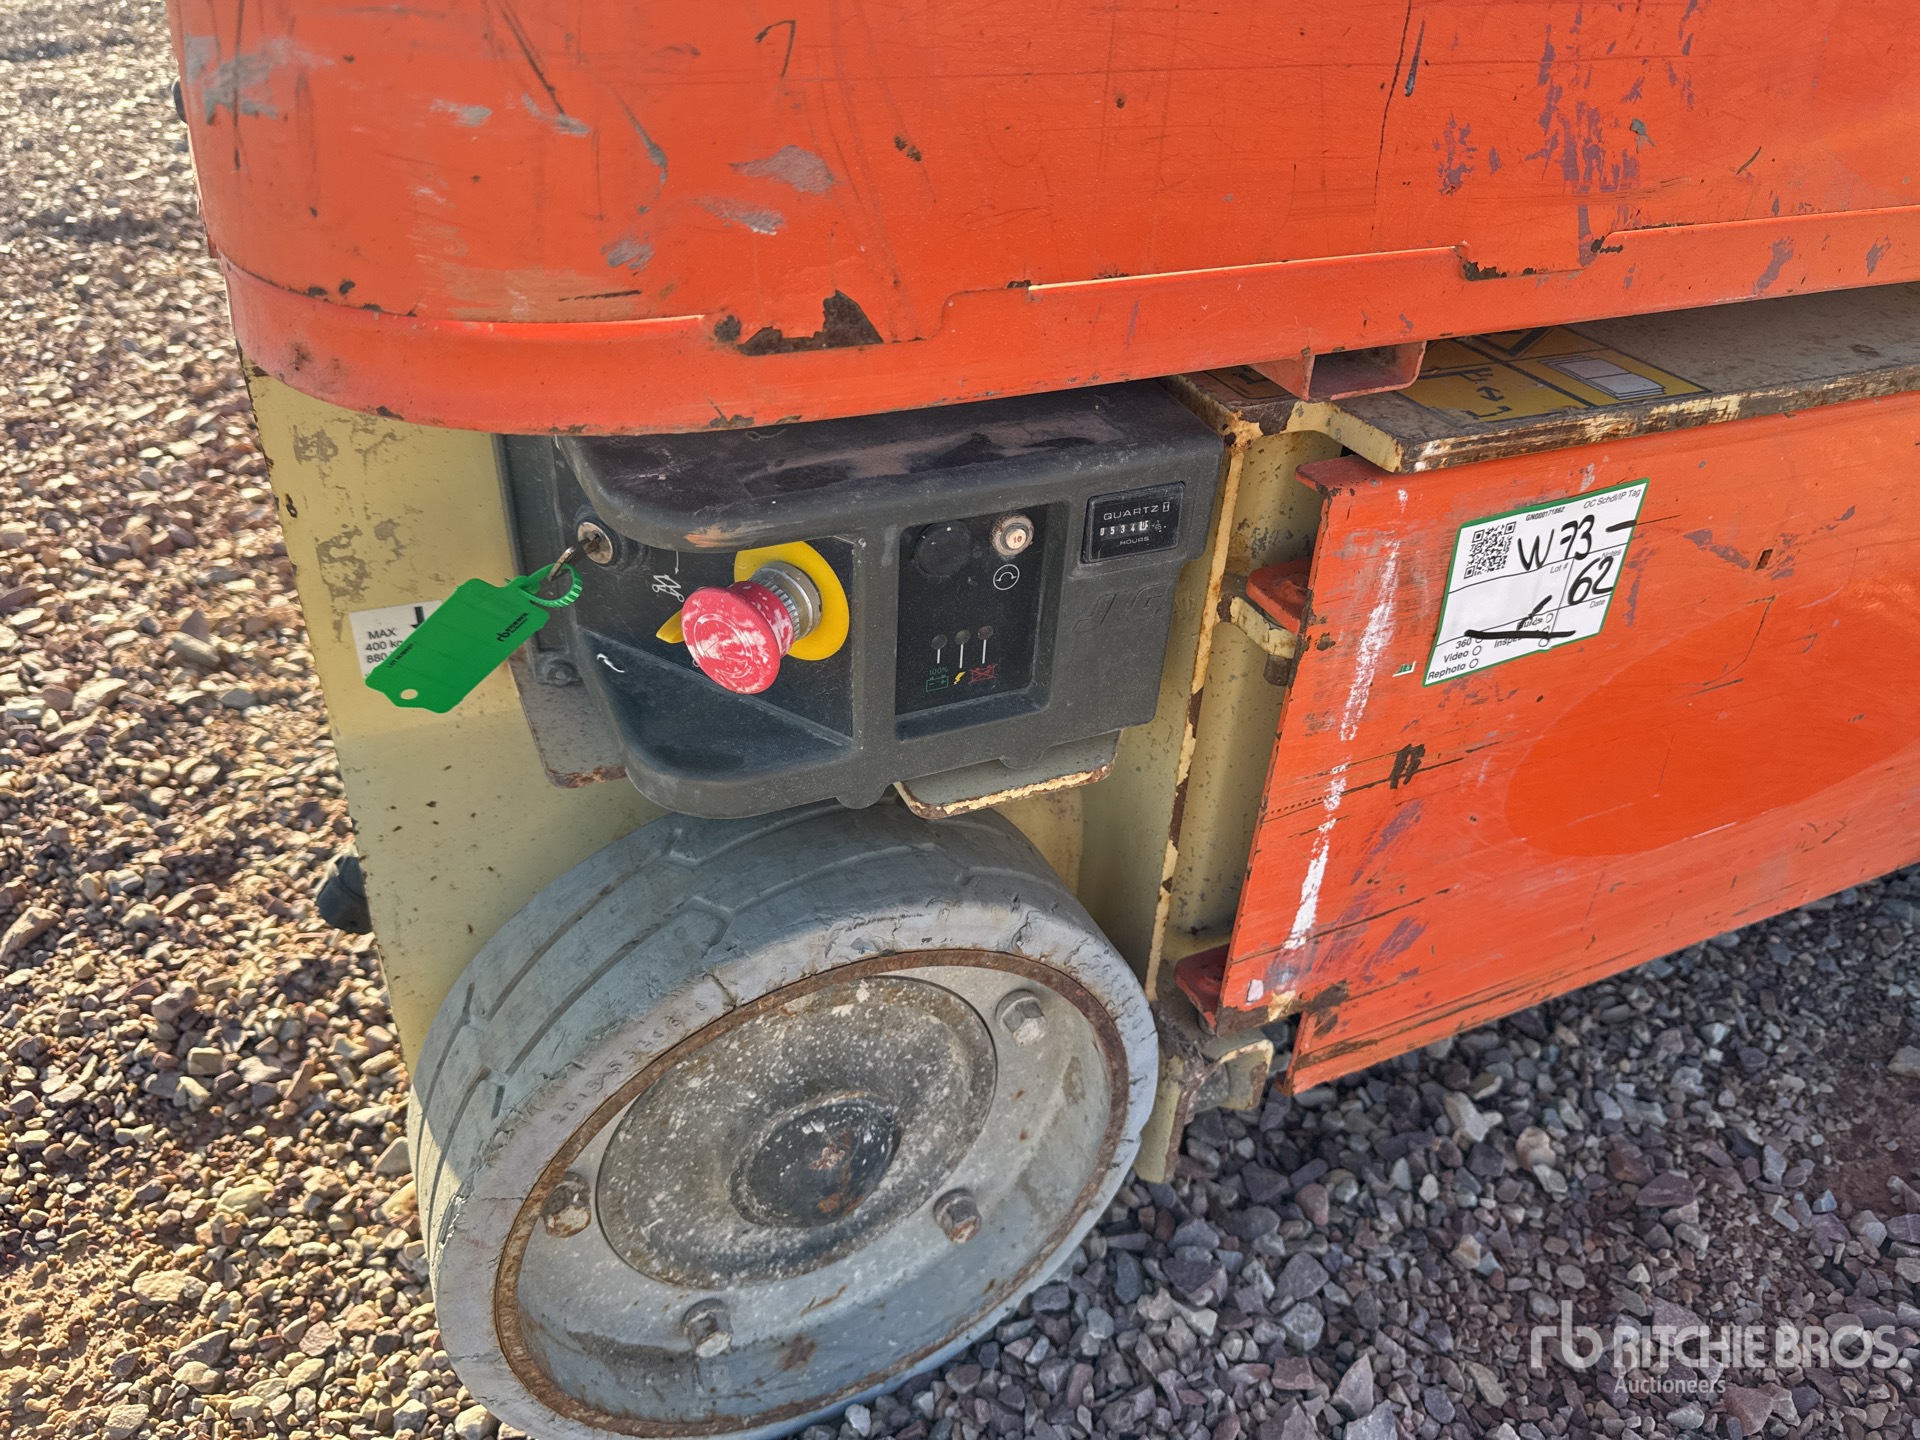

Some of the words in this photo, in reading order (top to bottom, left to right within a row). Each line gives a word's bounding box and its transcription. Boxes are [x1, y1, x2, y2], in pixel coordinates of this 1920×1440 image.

[1628, 489, 1642, 498] Tag
[1103, 504, 1159, 520] QUARTZ
[1119, 536, 1150, 546] HOURS
[1601, 549, 1622, 560] Notes
[1550, 565, 1561, 574] Lot
[1568, 555, 1614, 605] 62
[1589, 599, 1606, 609] Date
[368, 627, 398, 640] MAX
[365, 641, 388, 652] 400
[1455, 637, 1472, 650] 360
[1443, 650, 1469, 663] Video
[1427, 663, 1466, 681] Rephoto
